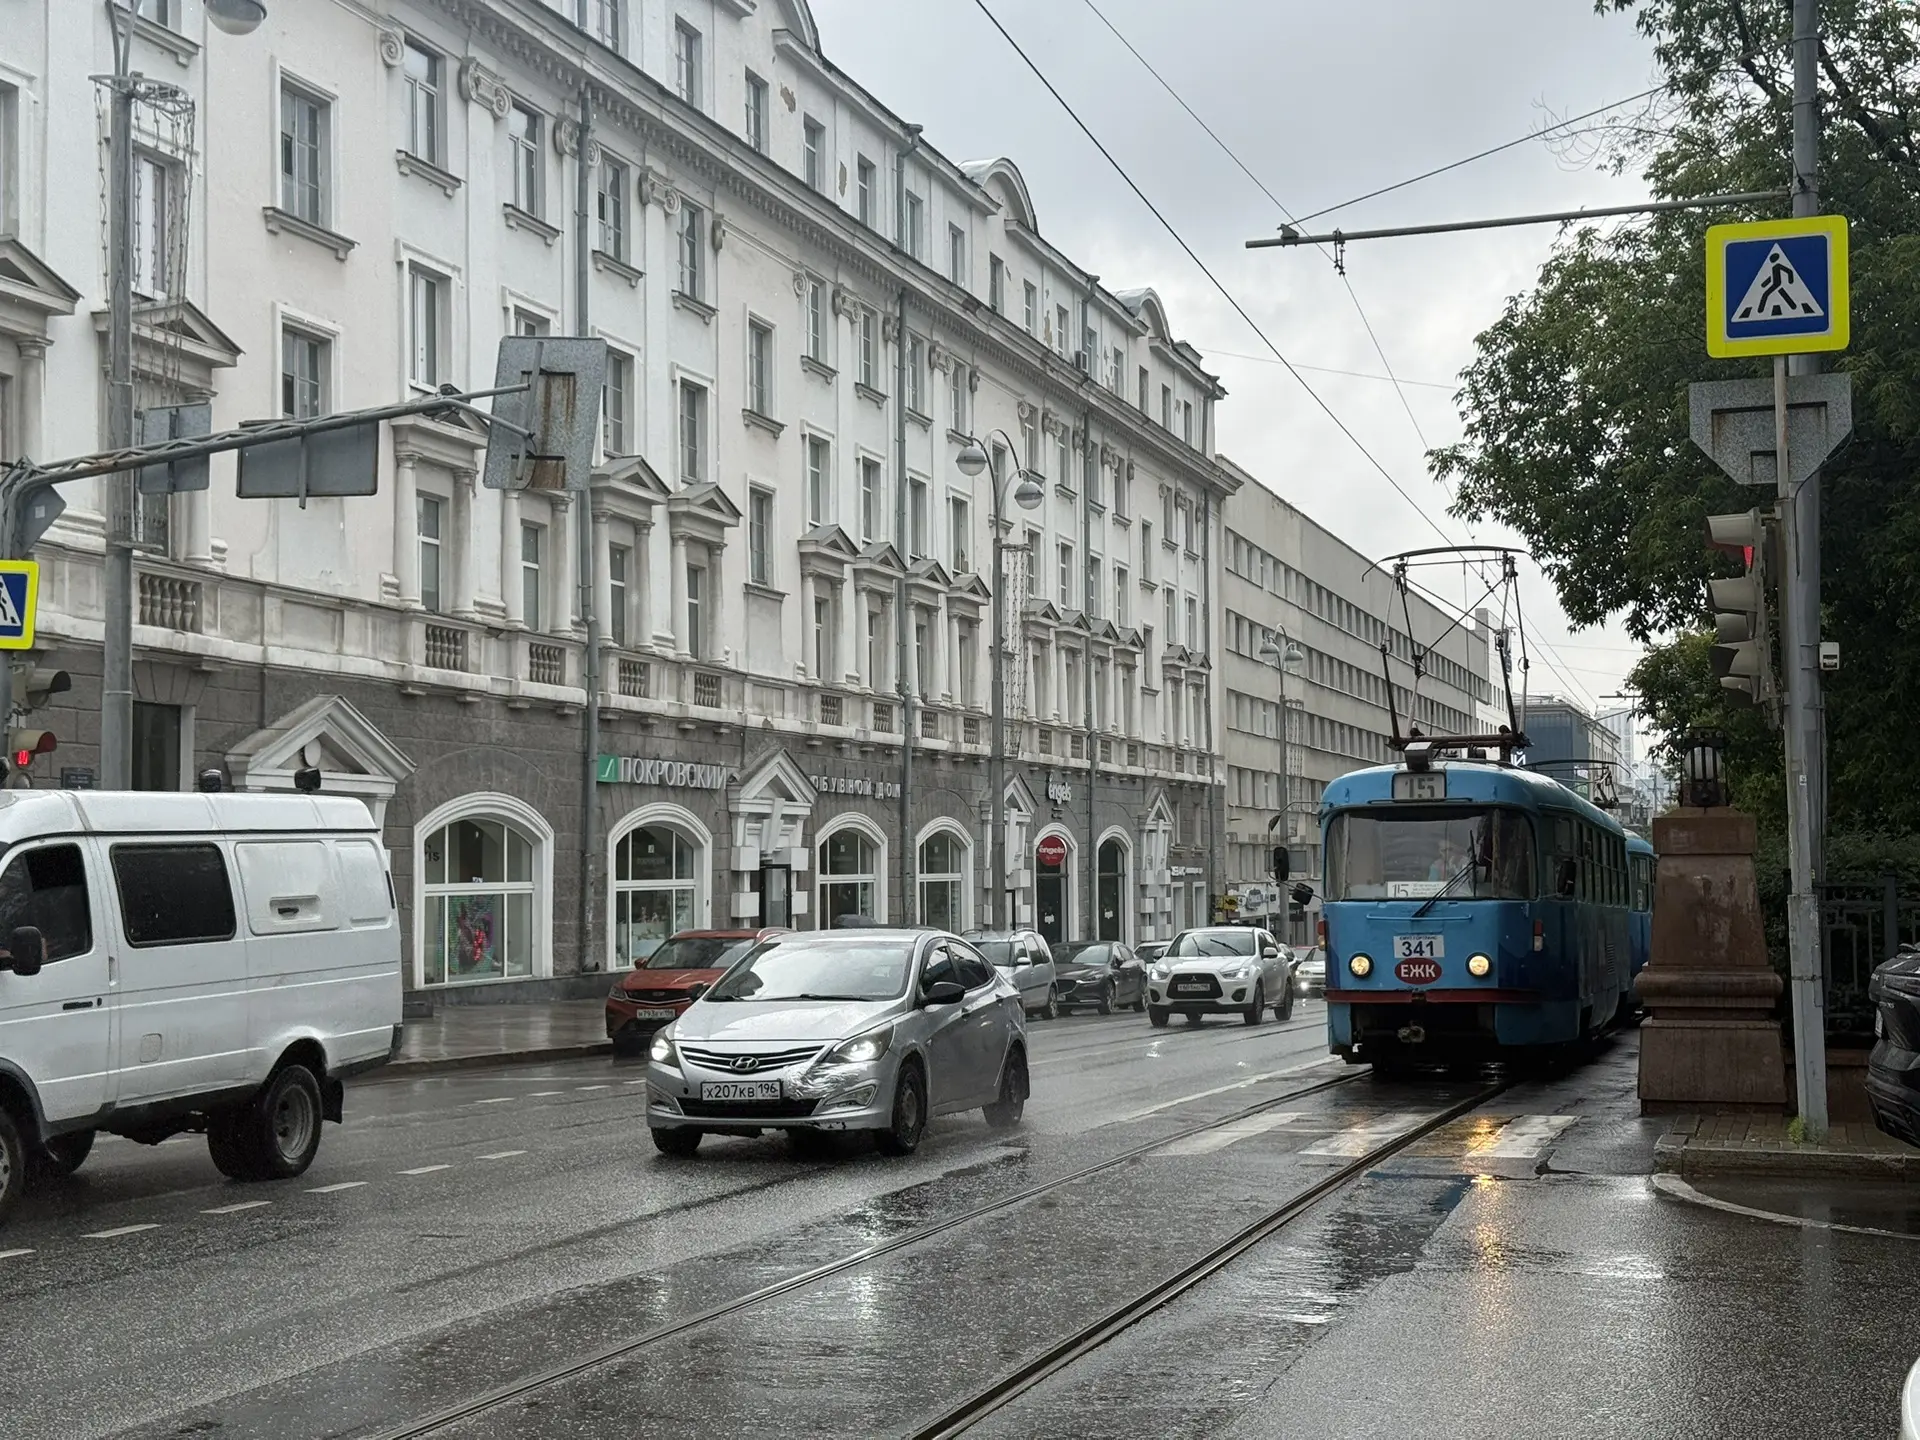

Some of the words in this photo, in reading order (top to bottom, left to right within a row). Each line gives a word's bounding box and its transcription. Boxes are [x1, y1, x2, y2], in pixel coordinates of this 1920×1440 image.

[619, 757, 726, 790] ПОКРОВСКИЙ
[810, 775, 872, 796] ОБУВНОЙ
[1405, 777, 1435, 799] 15
[1392, 883, 1409, 898] 15
[1401, 940, 1434, 957] 341
[1400, 964, 1436, 978] ЕЖК
[706, 1084, 755, 1098] Х207КВ
[758, 1083, 778, 1094] 196
